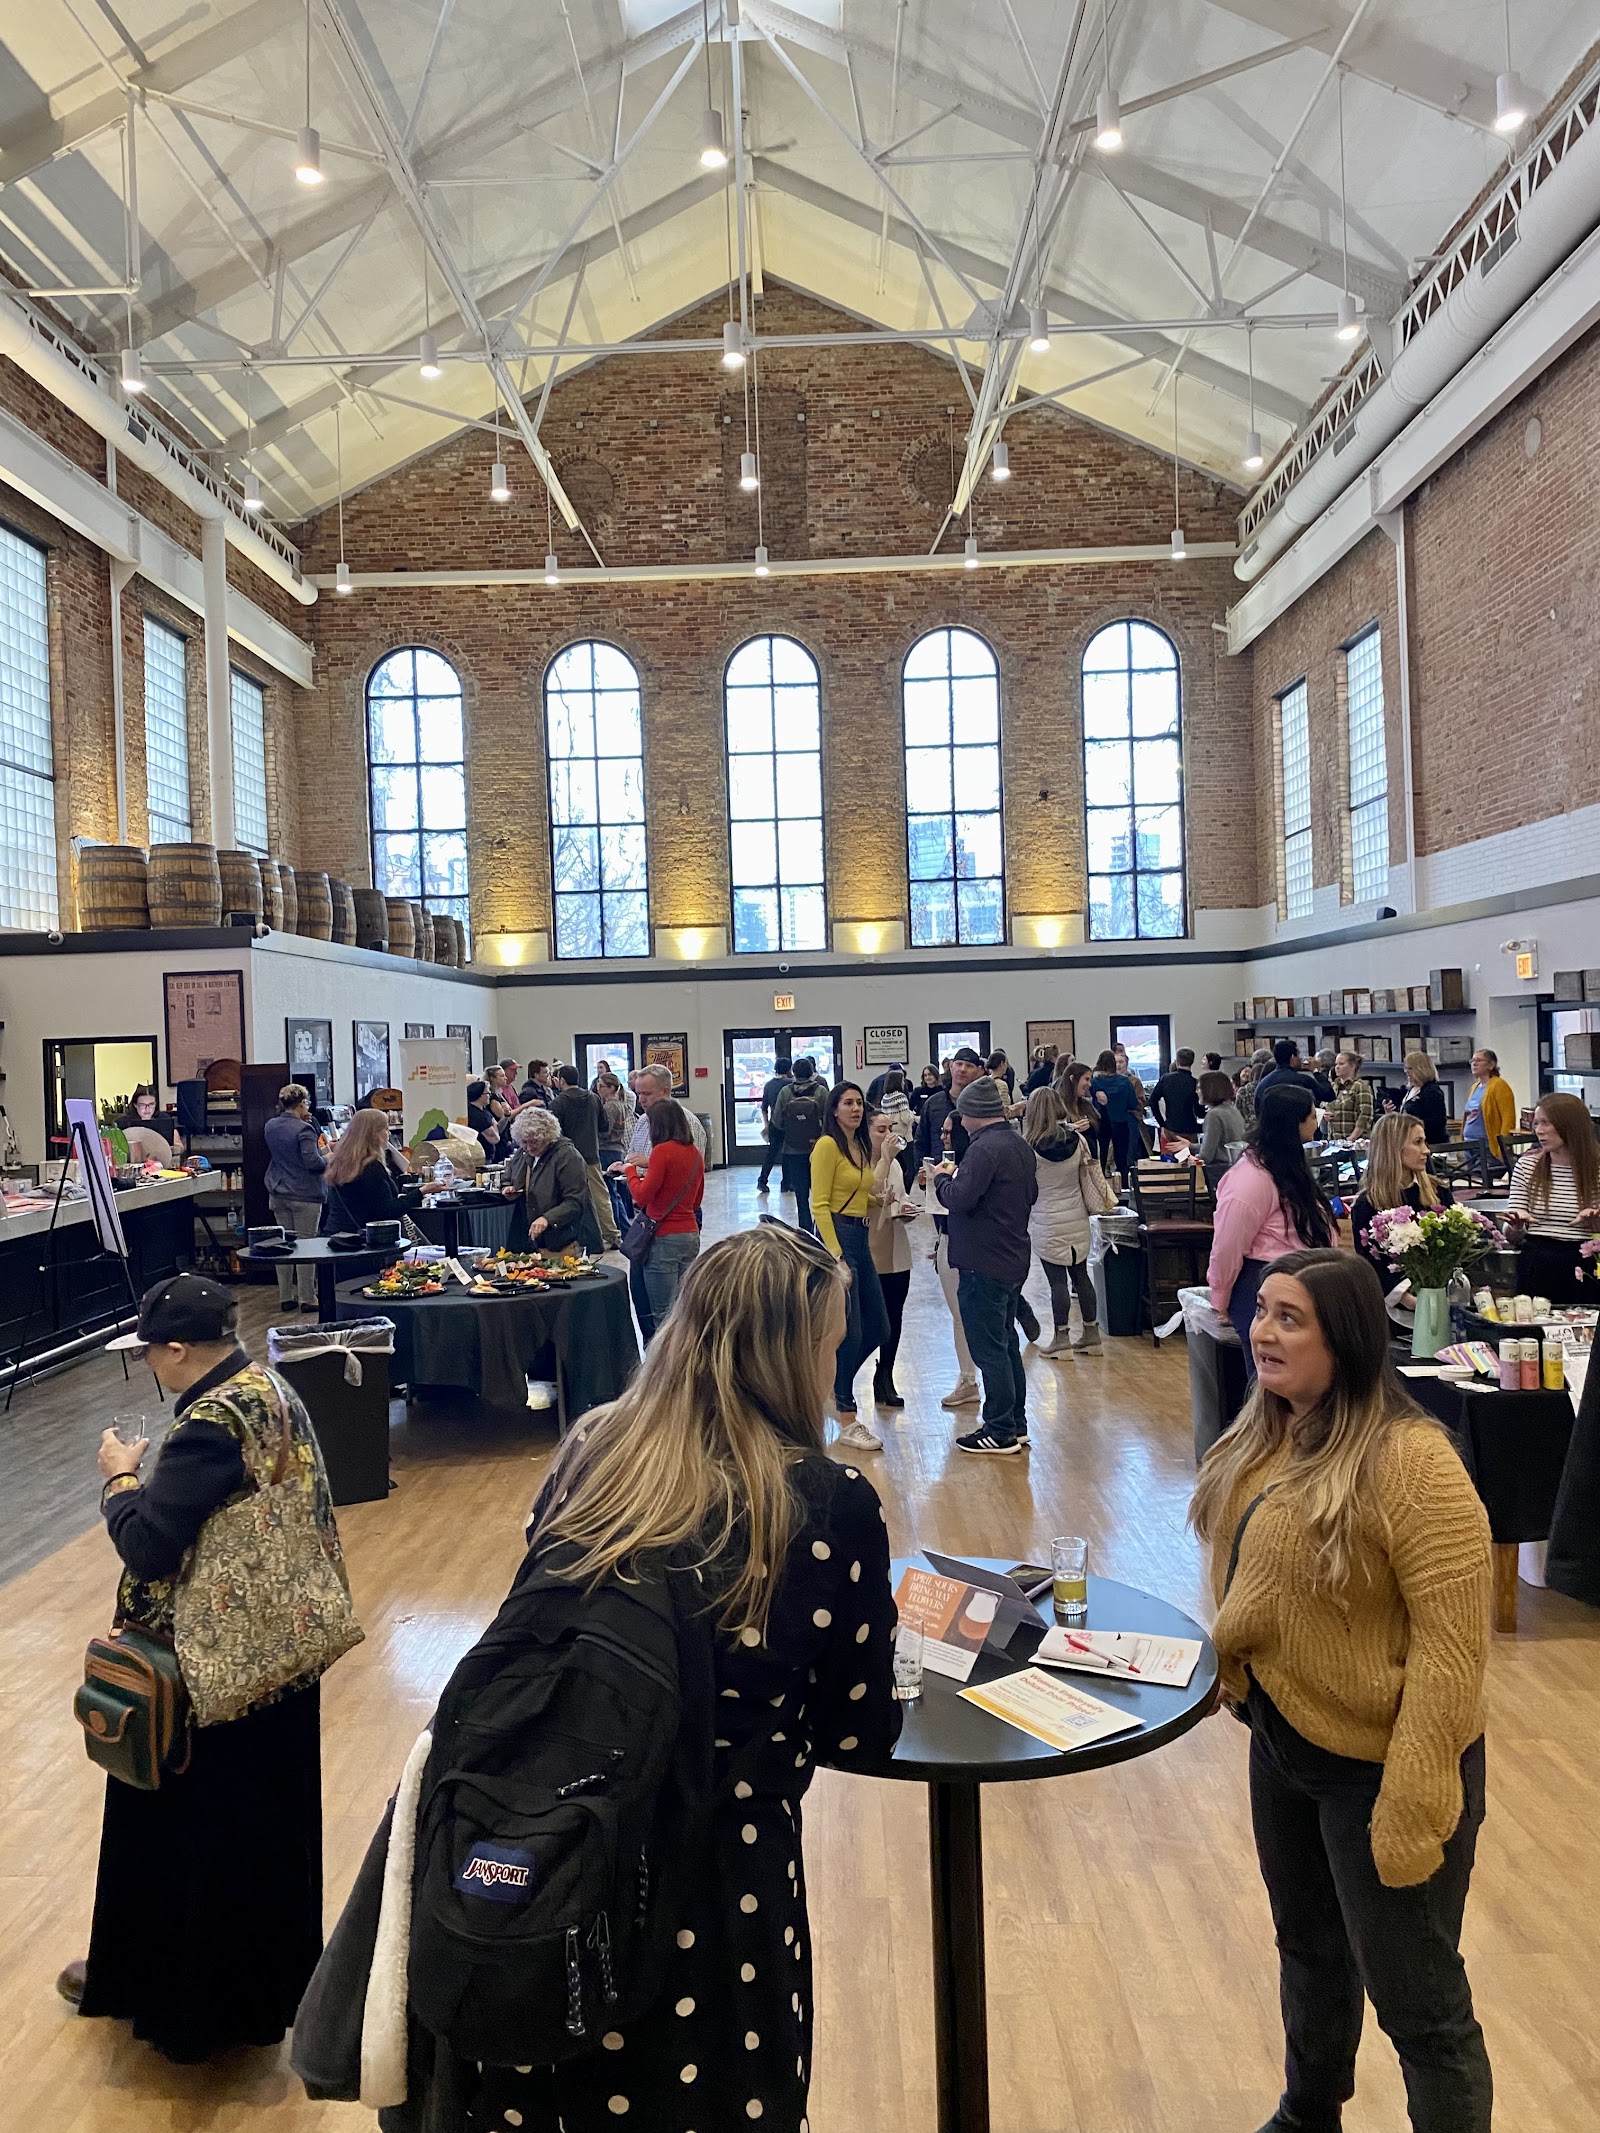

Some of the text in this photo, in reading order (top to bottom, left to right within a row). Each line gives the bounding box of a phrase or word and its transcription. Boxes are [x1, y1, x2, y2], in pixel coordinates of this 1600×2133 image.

[1518, 957, 1530, 976] EXIT
[776, 996, 792, 1008] EXIT
[870, 1029, 903, 1038] CLOSED
[428, 1072, 456, 1081] Employed
[912, 1572, 959, 1593] APRIL SOURS
[908, 1592, 945, 1610] FLOWERS
[910, 1582, 952, 1602] BRING MAY
[1019, 1676, 1046, 1693] Deluxe
[1030, 1673, 1059, 1691] Women
